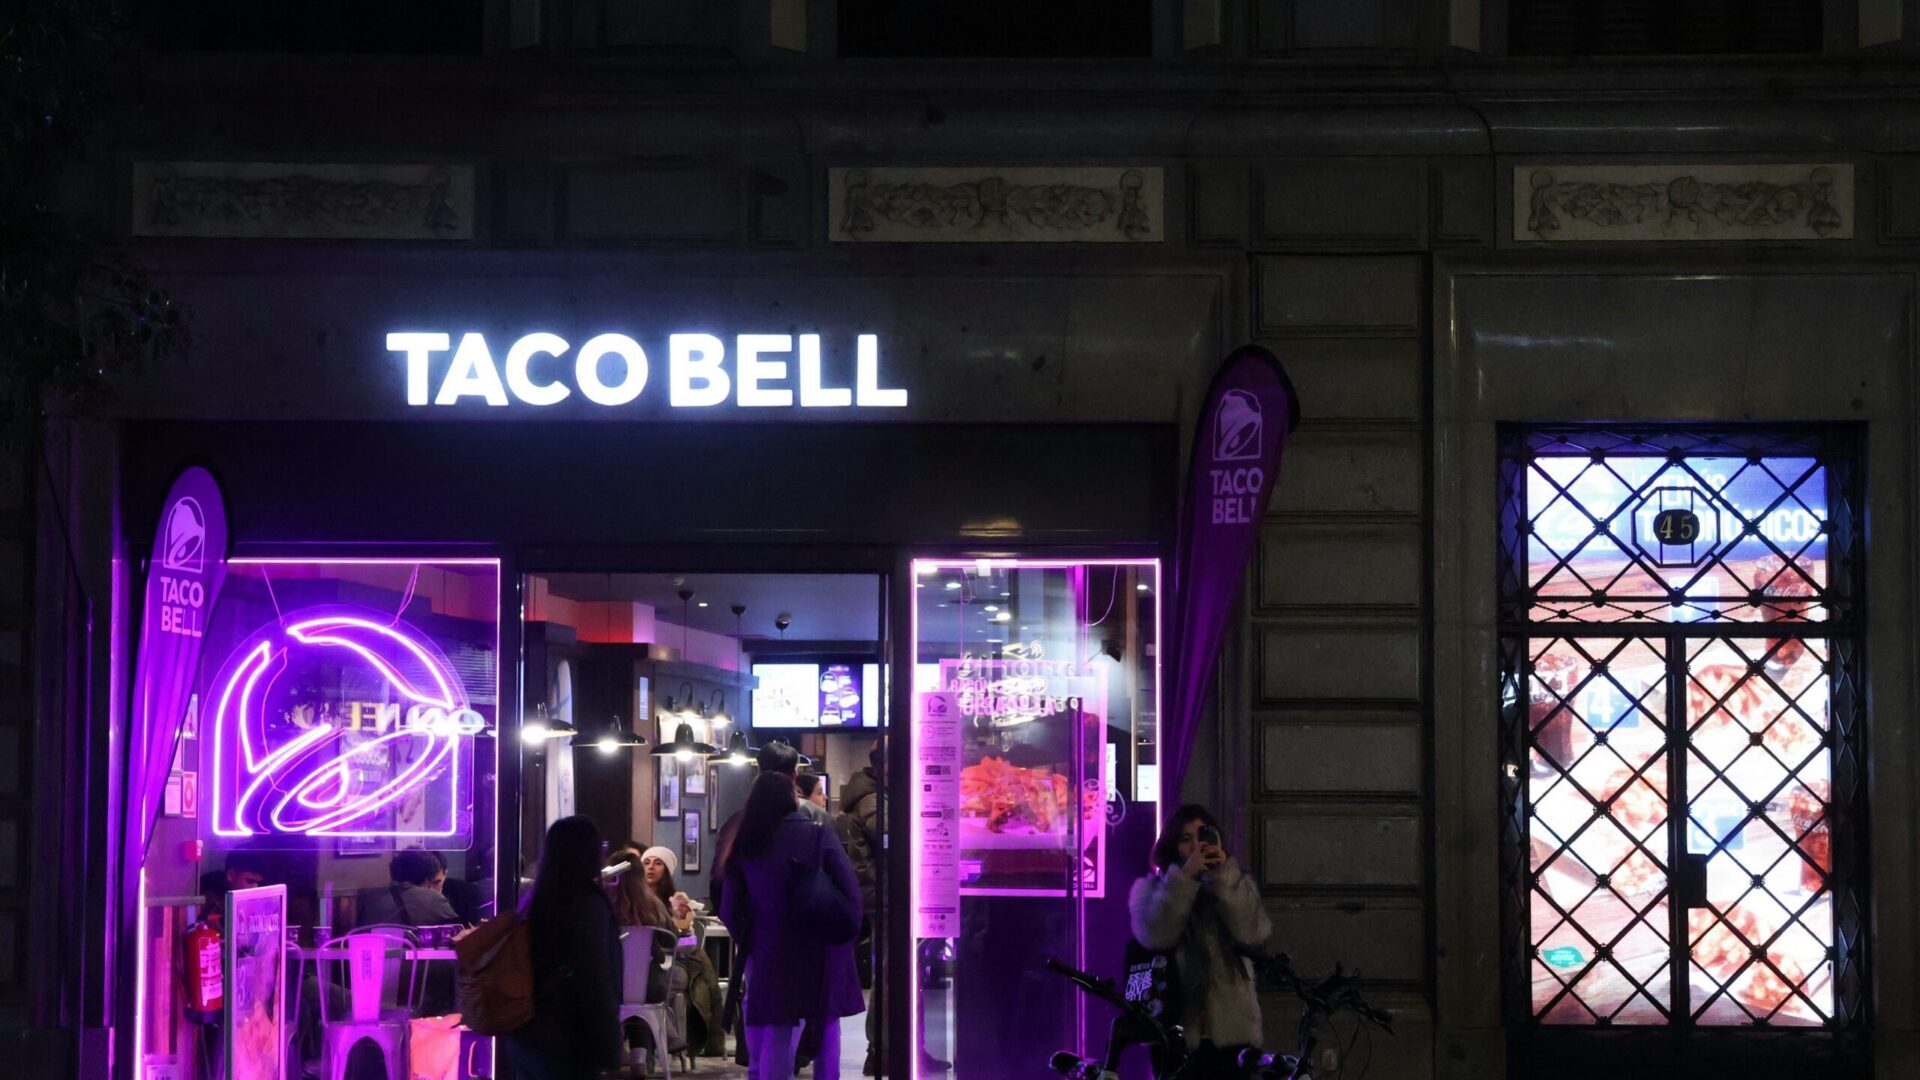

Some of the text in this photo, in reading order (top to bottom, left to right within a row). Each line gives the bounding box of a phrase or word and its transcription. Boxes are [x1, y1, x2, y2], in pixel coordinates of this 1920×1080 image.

[386, 332, 908, 407] TACO BELL
[1210, 467, 1264, 497] TACO
[1659, 513, 1694, 540] 45
[160, 576, 204, 609] TACO
[161, 605, 203, 638] BELL
